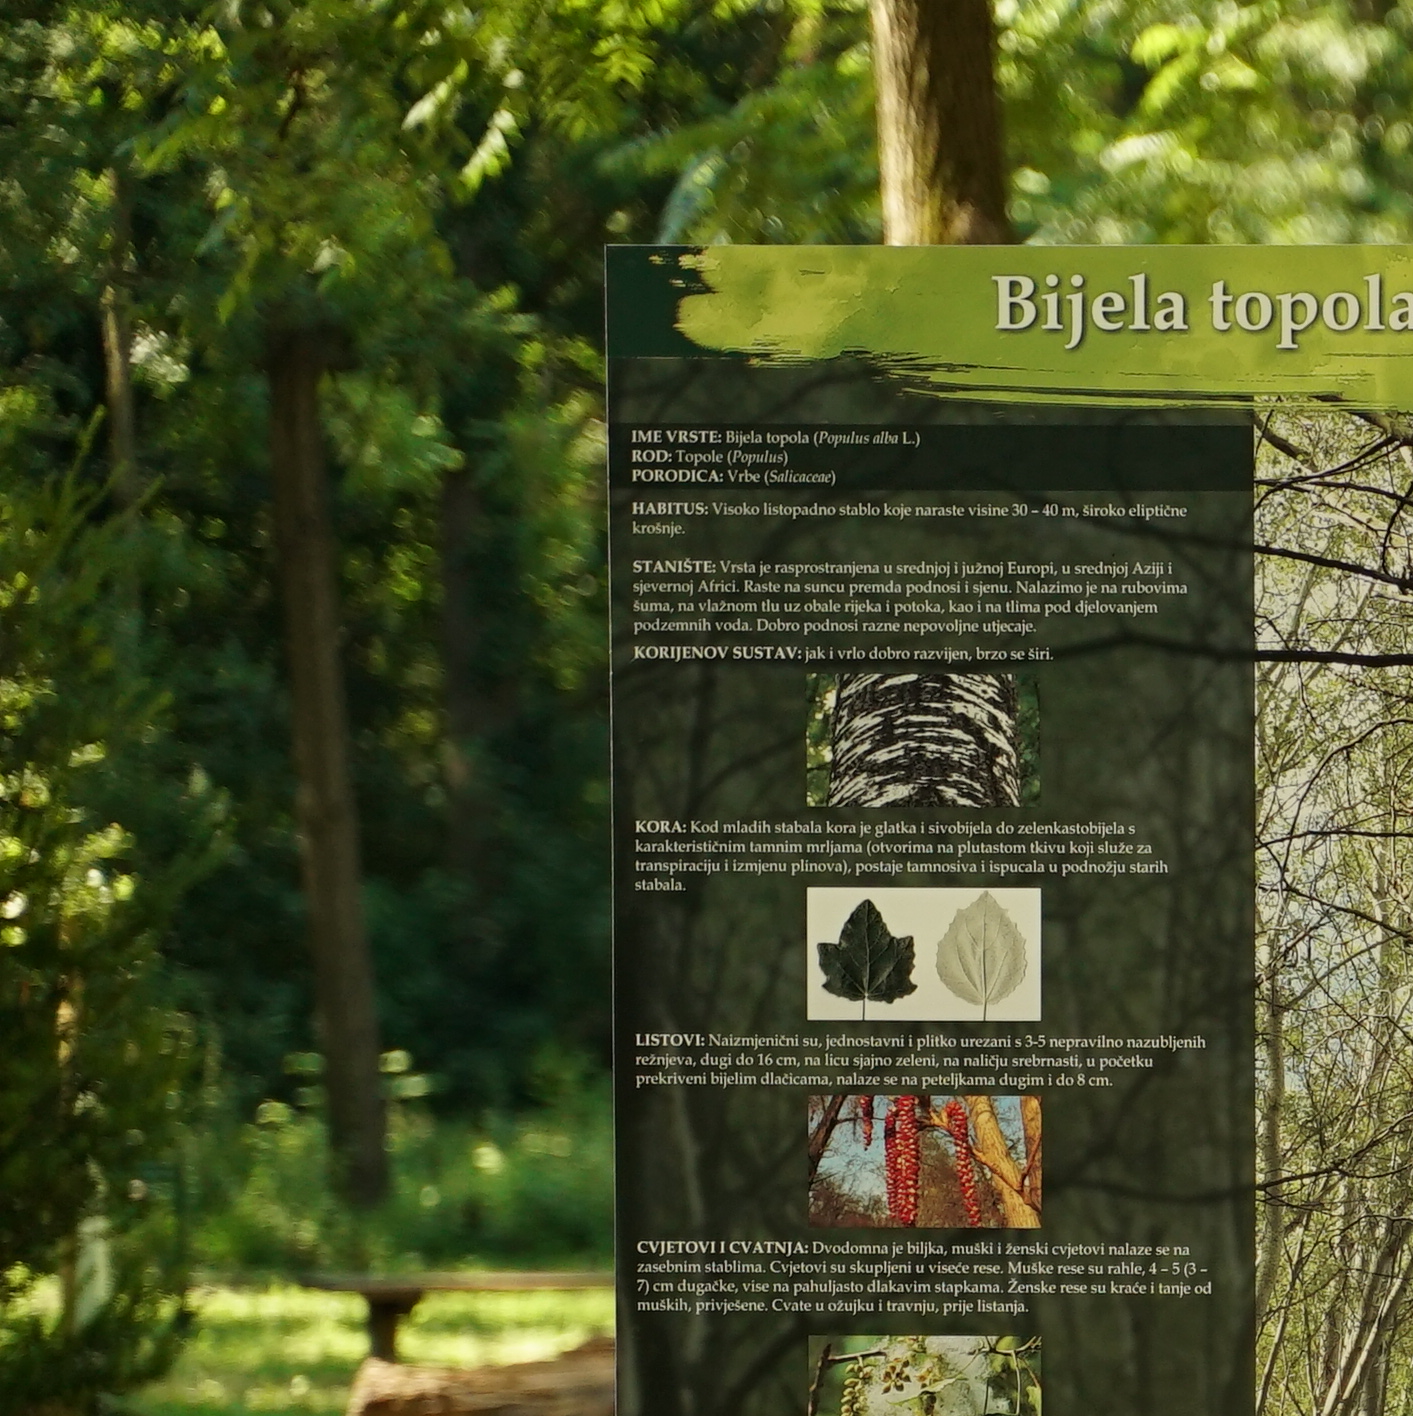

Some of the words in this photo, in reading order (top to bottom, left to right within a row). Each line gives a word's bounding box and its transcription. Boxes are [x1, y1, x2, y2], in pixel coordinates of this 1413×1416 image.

[992, 273, 1188, 349] Bijela
[631, 429, 662, 443] IME
[665, 429, 722, 443] VRSTE:
[725, 429, 762, 447] Bijela
[766, 430, 809, 448] topola
[813, 430, 870, 448] (Populus
[872, 430, 898, 444] alba
[902, 431, 920, 447] L.)
[631, 449, 672, 462] ROD:
[675, 449, 723, 466] Topole
[726, 449, 788, 467] (Populus)
[631, 468, 723, 482] PORODICA:
[727, 468, 760, 482] Vrbe
[763, 469, 836, 486] (Salicaceae)
[631, 501, 708, 515] HABITUS:
[711, 501, 760, 515] Visoko
[763, 501, 836, 519] listopadno
[838, 502, 880, 516] stablo
[883, 502, 912, 520] koje
[914, 504, 965, 516] naraste
[967, 503, 1009, 516] visine
[1011, 503, 1028, 516] 30
[1041, 503, 1058, 516] 40
[1061, 506, 1079, 519] m,
[1082, 502, 1126, 516] široko
[1128, 503, 1187, 520] eliptične
[632, 520, 685, 538] krošnje.
[632, 557, 716, 573] STANIŠTE:
[719, 559, 756, 573] Vrsta
[758, 560, 771, 577] je
[774, 560, 880, 577] rasprostranjena
[883, 564, 892, 573] u
[896, 560, 950, 578] srednjoj
[954, 561, 958, 574] i
[961, 561, 1003, 578] južnoj
[1007, 560, 1058, 578] Europi,
[1061, 564, 1070, 574] u
[1074, 561, 1128, 578] srednjoj
[1131, 561, 1164, 578] Aziji
[1167, 561, 1172, 574] i
[633, 645, 729, 662] KORIJENOV
[732, 645, 802, 659] SUSTAV:
[804, 645, 826, 663] jak
[829, 646, 833, 659] i
[837, 645, 865, 659] vrlo
[868, 645, 910, 659] dobro
[913, 646, 972, 663] razvijen,
[975, 646, 1007, 660] brzo
[1010, 650, 1025, 660] se
[1027, 646, 1053, 660] širi.
[635, 819, 686, 833] KORA:
[690, 819, 718, 833] Kod
[722, 819, 771, 833] mladih
[774, 820, 822, 833] stabala
[825, 820, 856, 833] kora
[859, 821, 871, 837] je
[874, 820, 916, 838] glatka
[920, 821, 924, 833] i
[928, 820, 992, 837] sivobijela
[995, 820, 1014, 834] do
[1017, 820, 1125, 838] zelenkastobijela
[1128, 824, 1135, 834] s
[634, 877, 686, 891] stabala.
[635, 1033, 705, 1046] LISTOVI:
[708, 1033, 799, 1050] Naizmjenični
[802, 1037, 822, 1050] su,
[825, 1033, 904, 1051] jednostavni
[908, 1034, 913, 1047] i
[916, 1033, 957, 1051] plitko
[960, 1034, 1011, 1047] urezani
[1014, 1038, 1022, 1047] s
[1024, 1034, 1046, 1047] 3-5
[1049, 1034, 1123, 1051] nepravilno
[1126, 1034, 1206, 1052] nazubljenih
[636, 1240, 715, 1256] CVJETOVI
[719, 1240, 725, 1253] I
[728, 1240, 808, 1257] CVATNJA:
[812, 1240, 888, 1254] Dvodomna
[891, 1241, 903, 1258] je
[906, 1240, 947, 1258] biljka,
[951, 1241, 993, 1254] muški
[997, 1242, 1001, 1254] i
[1005, 1241, 1048, 1255] ženski
[1051, 1242, 1104, 1259] cvjetovi
[1108, 1242, 1152, 1255] nalaze
[1155, 1246, 1170, 1255] se
[1173, 1246, 1190, 1255] na
